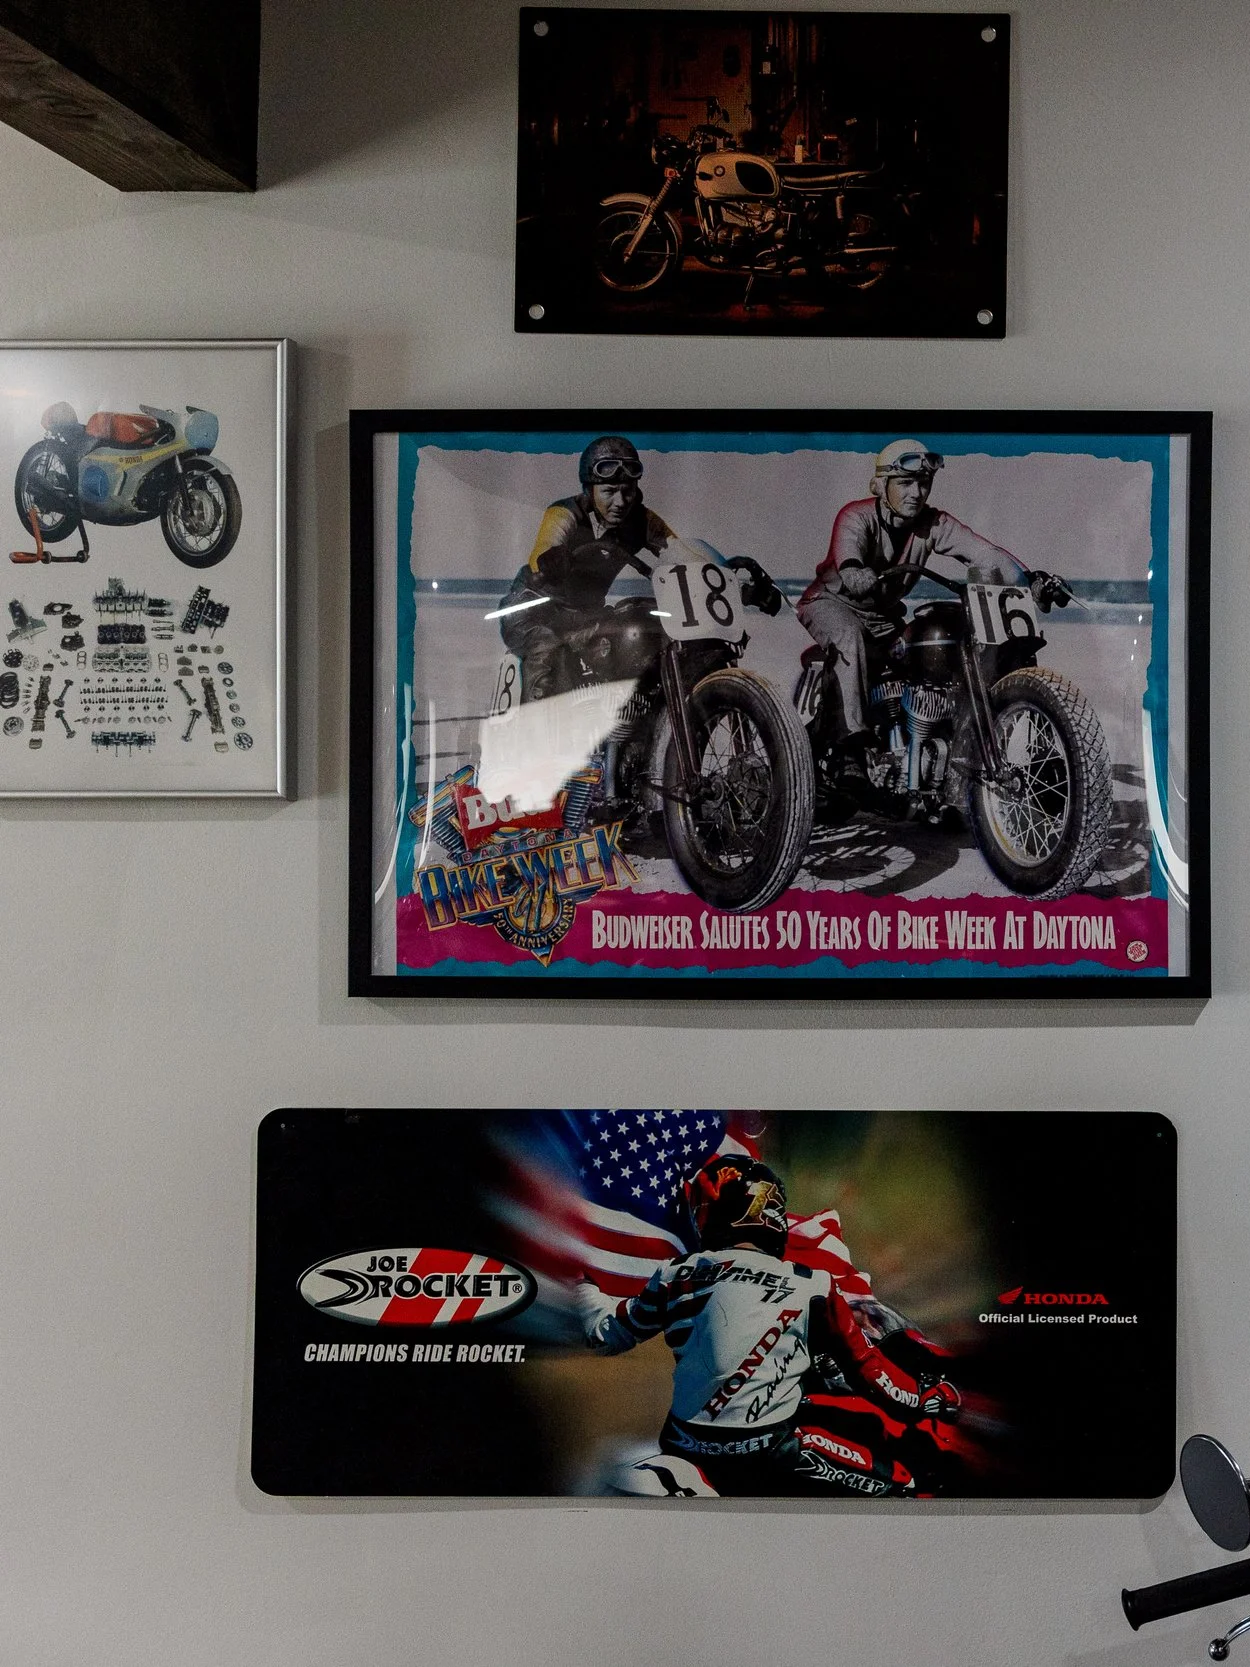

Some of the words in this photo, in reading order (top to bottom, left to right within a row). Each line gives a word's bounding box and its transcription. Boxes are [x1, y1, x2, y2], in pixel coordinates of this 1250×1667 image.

[668, 563, 734, 627] 18
[976, 585, 1036, 643] 16
[462, 794, 553, 830] Bu
[461, 829, 576, 863] DAYTONA
[416, 861, 514, 931] BIKE
[515, 820, 641, 894] WEEK
[509, 897, 575, 949] ANNIVERSARY
[591, 910, 694, 949] BUDWEISER
[700, 910, 770, 950] SALUTES
[775, 910, 802, 950] 50
[806, 910, 862, 950] YEARS
[867, 910, 891, 950] OF
[897, 910, 939, 949] BIKE
[945, 910, 997, 949] WEEK
[1003, 910, 1027, 949] AT
[1033, 910, 1117, 949] DAYTONA
[366, 1255, 408, 1273] JOE
[760, 1288, 796, 1304] 17
[1023, 1293, 1109, 1305] HONDA
[978, 1313, 1024, 1323] Official
[1028, 1313, 1085, 1324] Licensed
[1088, 1314, 1138, 1324] Product
[304, 1343, 409, 1363] CHAMPIONS
[412, 1343, 453, 1363] RIDE
[456, 1344, 526, 1363] ROCKET.
[702, 1308, 803, 1421] HONDA
[745, 1335, 807, 1424] Racing
